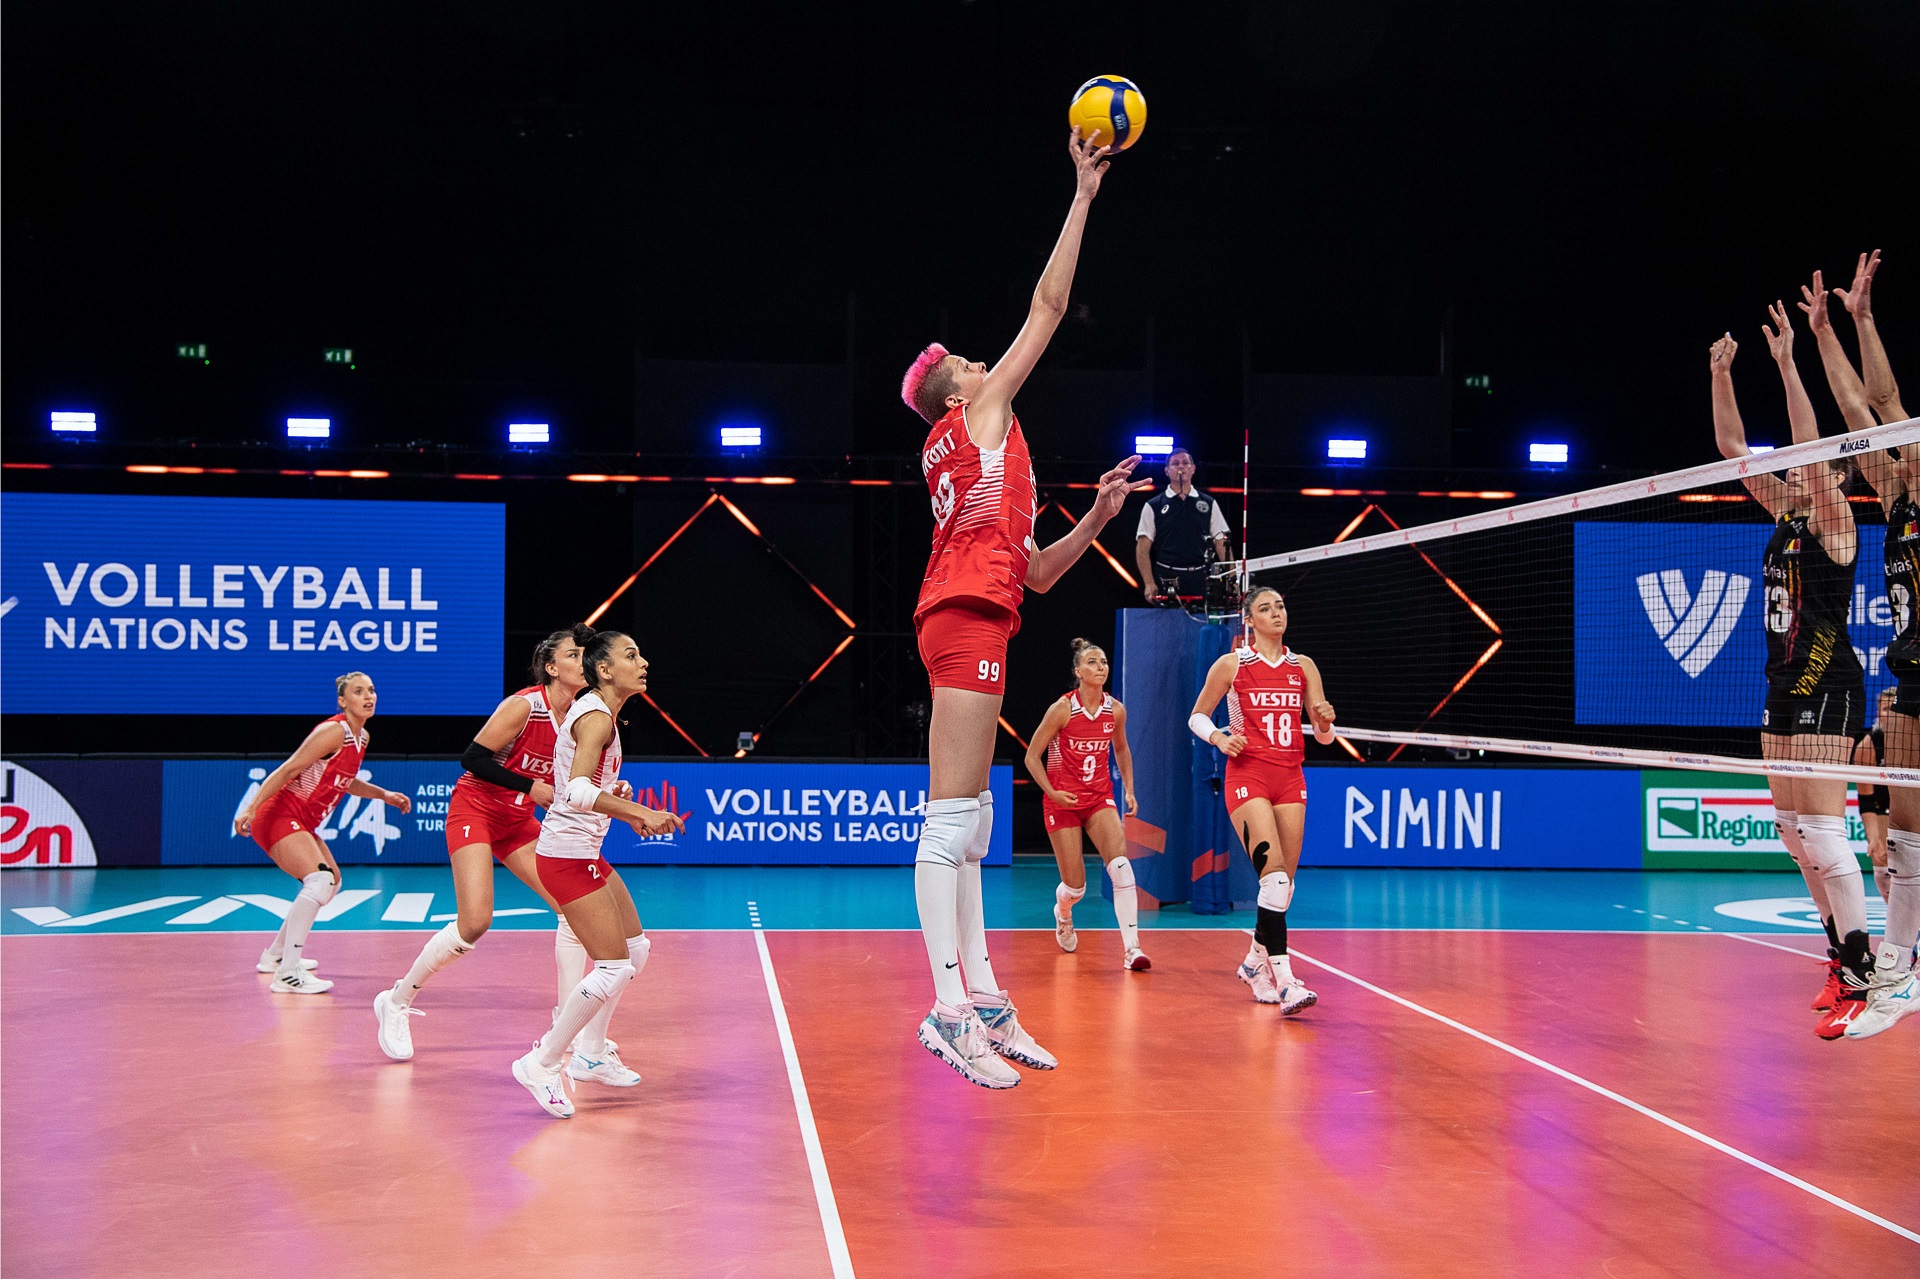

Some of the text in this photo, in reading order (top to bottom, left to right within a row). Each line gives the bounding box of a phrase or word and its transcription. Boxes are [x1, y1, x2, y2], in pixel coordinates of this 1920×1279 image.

[42, 561, 439, 611] VOLLEYBALL
[44, 616, 438, 653] NATIONS LEAGUE
[977, 659, 1000, 682] 99
[1248, 691, 1300, 707] VESTEL
[1261, 712, 1293, 747] 18
[1082, 755, 1097, 782] 9
[705, 788, 927, 817] VOLLEYBALL
[1235, 786, 1249, 800] 18
[290, 820, 301, 831] 3
[1344, 785, 1502, 851] RIMINI
[706, 821, 823, 843] NATIONS
[588, 863, 600, 880] 2
